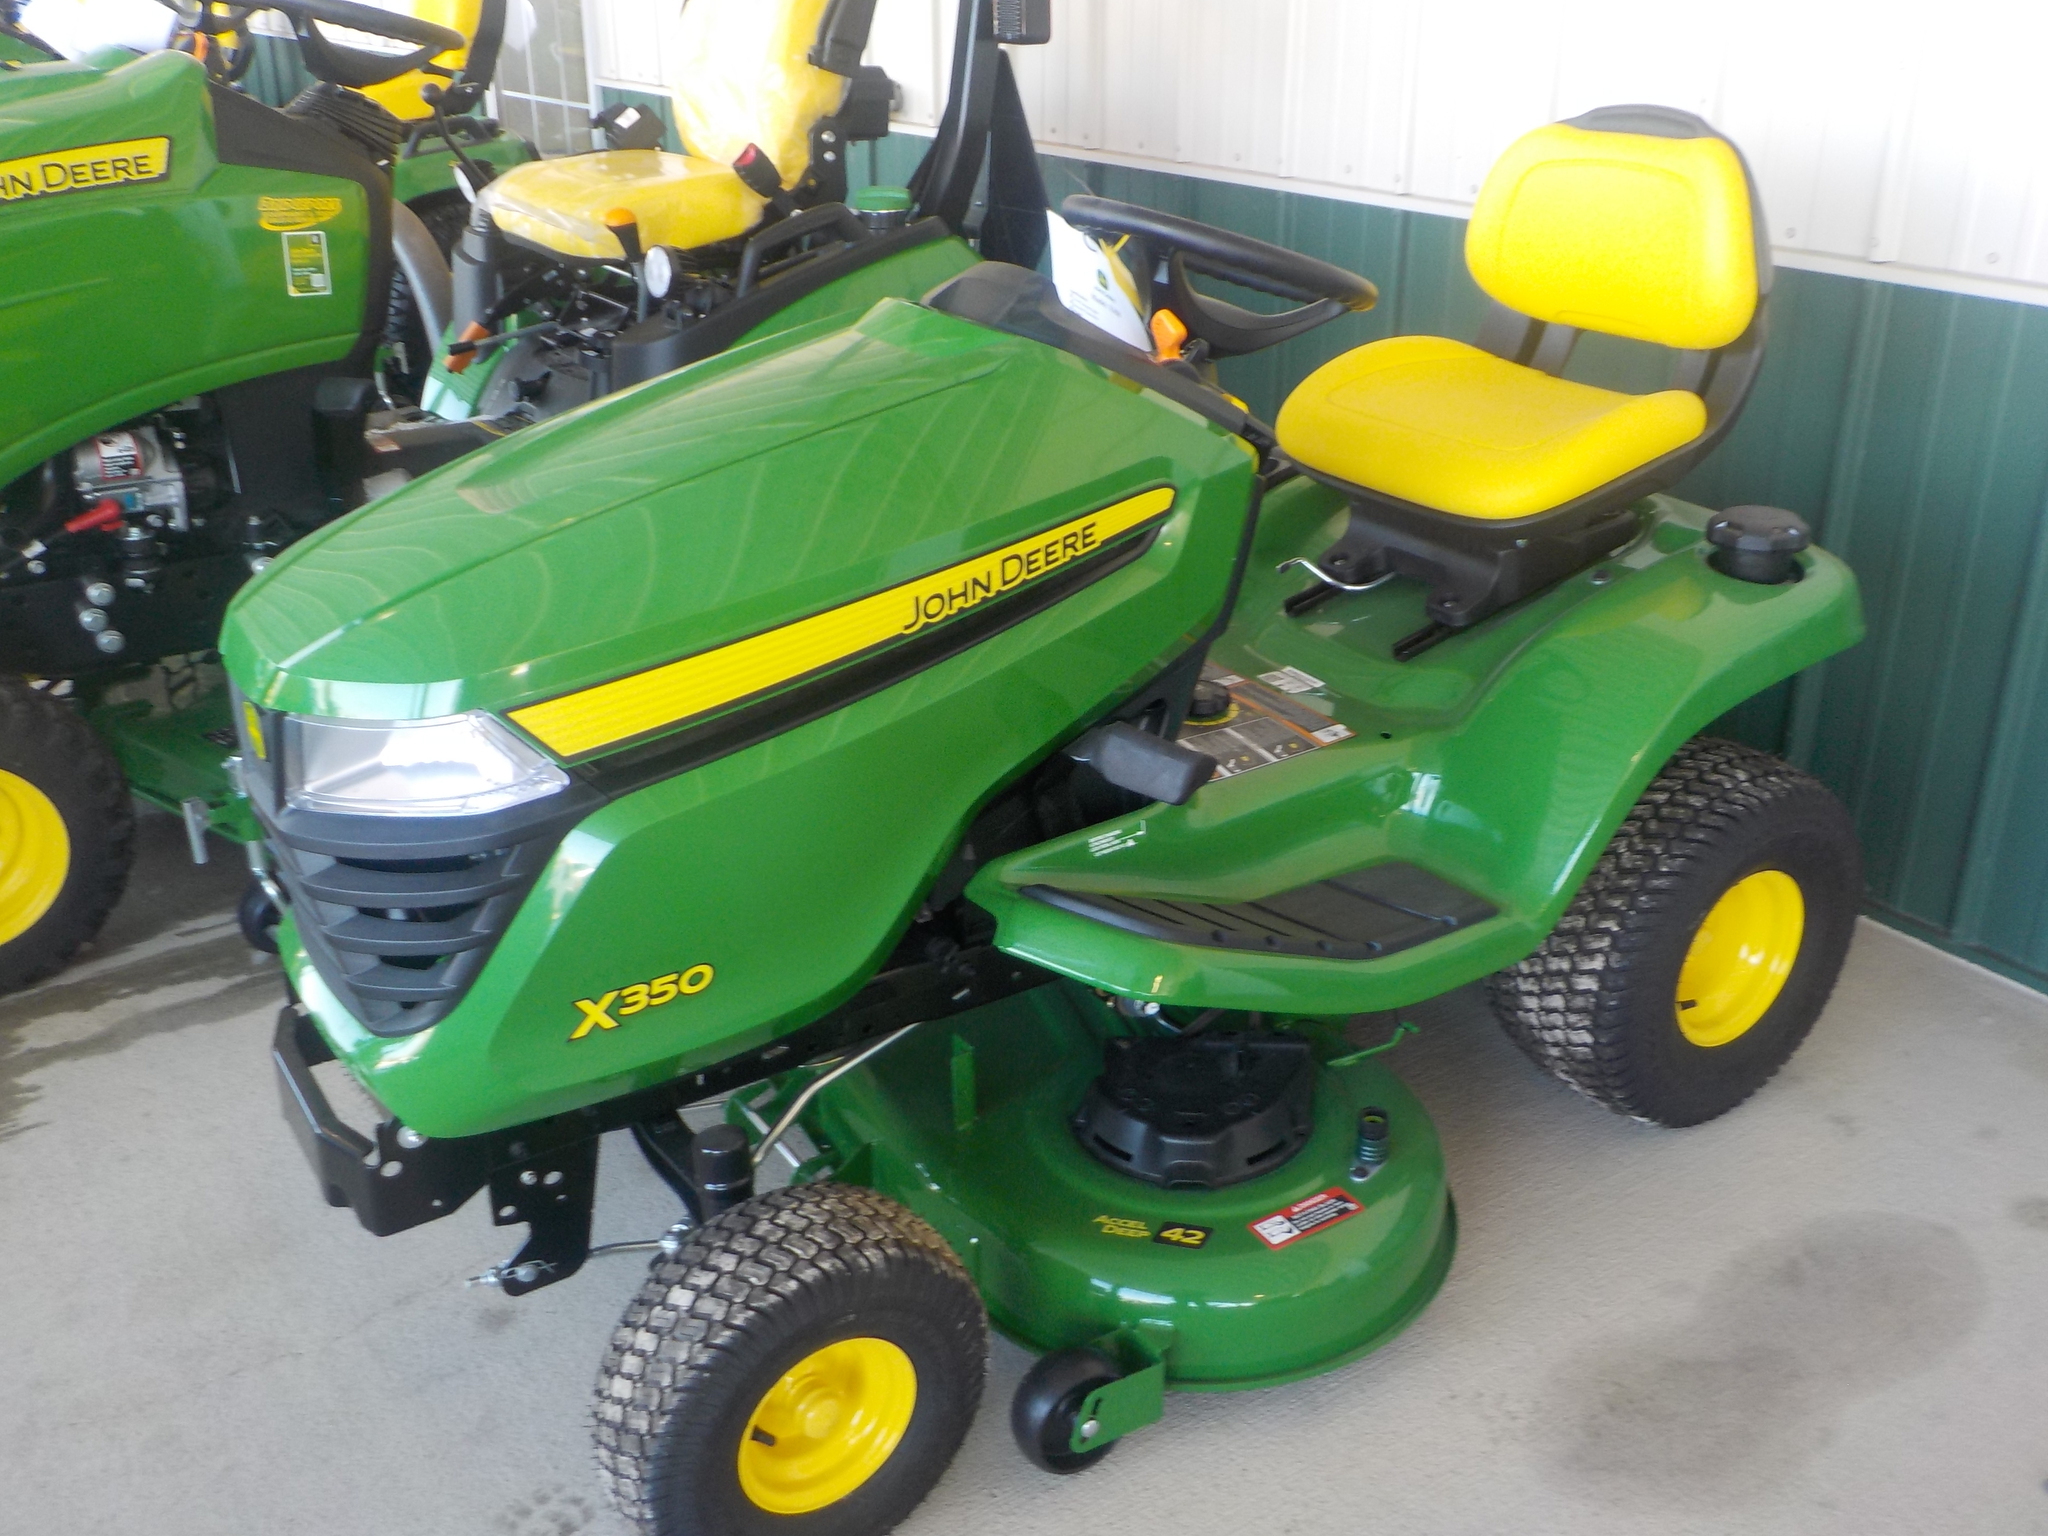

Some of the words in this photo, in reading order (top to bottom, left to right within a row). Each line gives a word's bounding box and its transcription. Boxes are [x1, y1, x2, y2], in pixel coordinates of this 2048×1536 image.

[40, 155, 152, 188] DEERE
[903, 570, 992, 630] JOHN
[1001, 521, 1097, 587] DEERE
[568, 963, 715, 1041] X350
[1092, 1215, 1147, 1229] ACCEL
[1101, 1224, 1151, 1238] DEEP
[1160, 1227, 1206, 1245] 42
